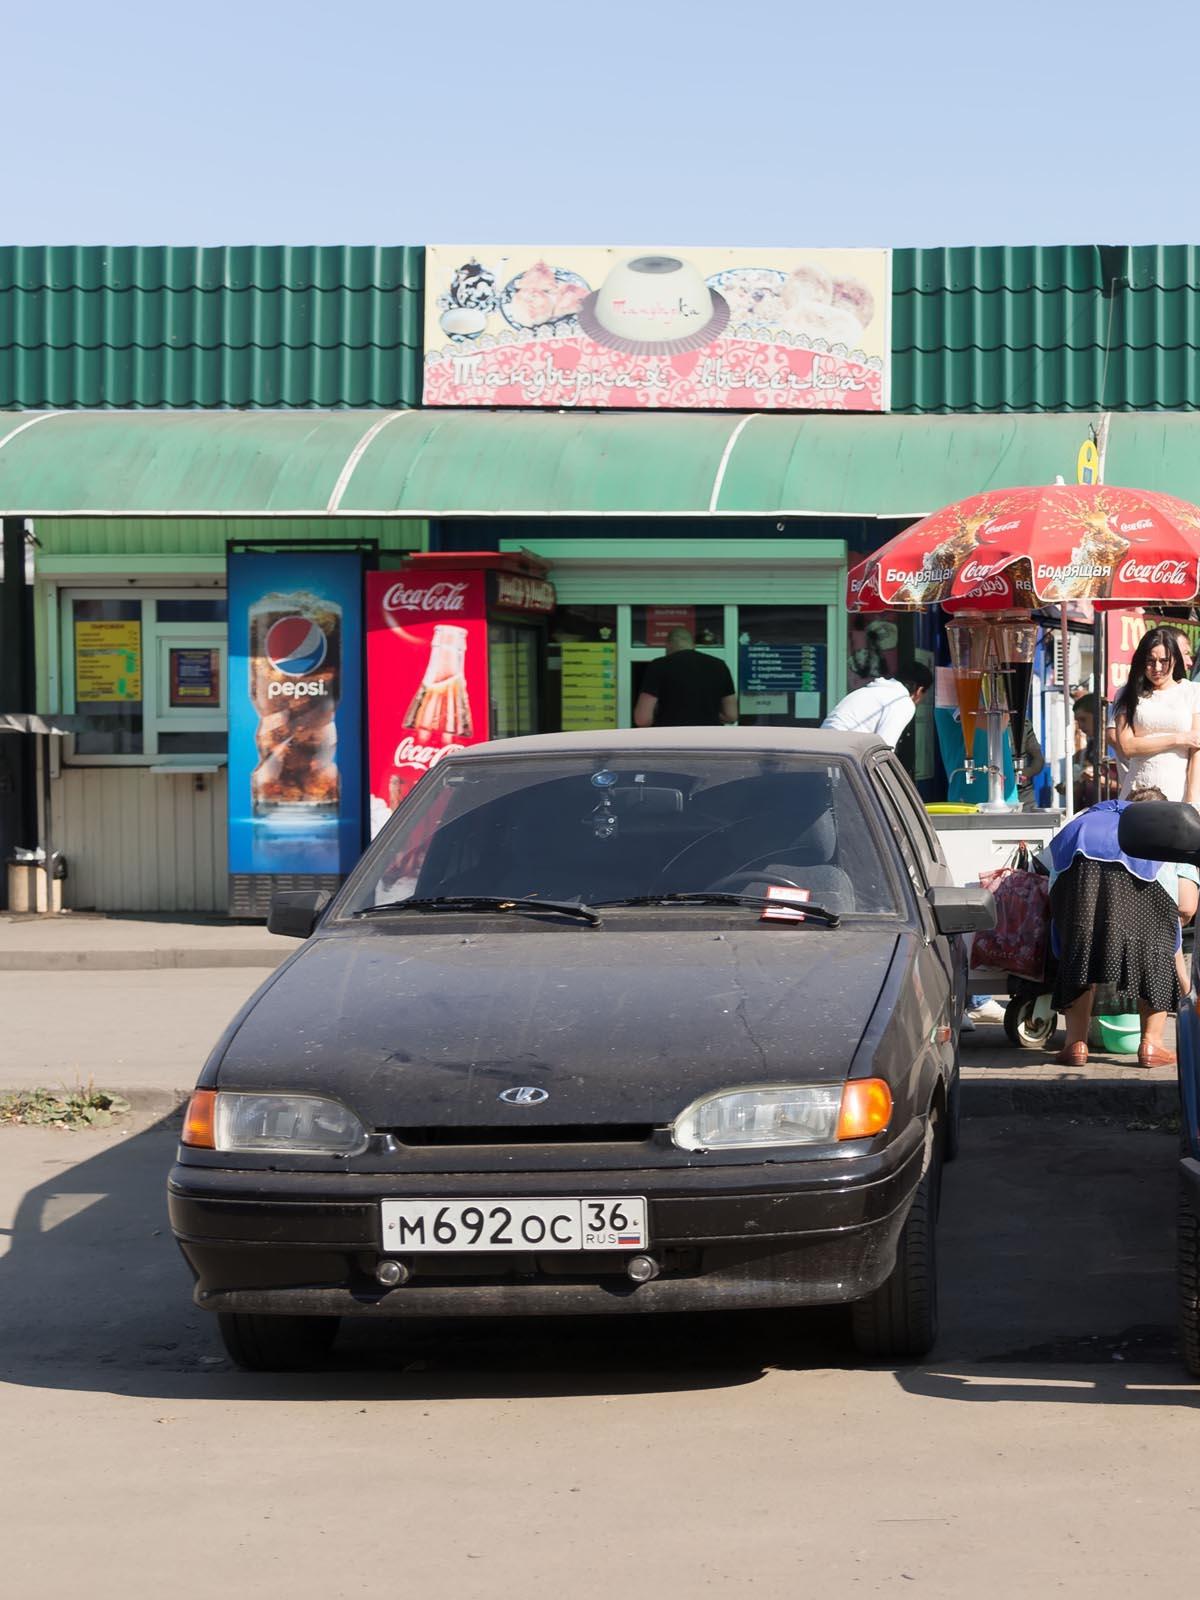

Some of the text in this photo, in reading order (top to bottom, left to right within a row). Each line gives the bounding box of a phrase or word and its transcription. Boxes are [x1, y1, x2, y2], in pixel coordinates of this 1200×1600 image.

[1037, 564, 1112, 581] Бодрящая
[1119, 559, 1191, 584] Coca-Cola
[383, 582, 468, 612] Coca-Cola
[268, 679, 324, 699] pepsi
[588, 1203, 628, 1232] 36
[586, 1233, 617, 1245] RUS
